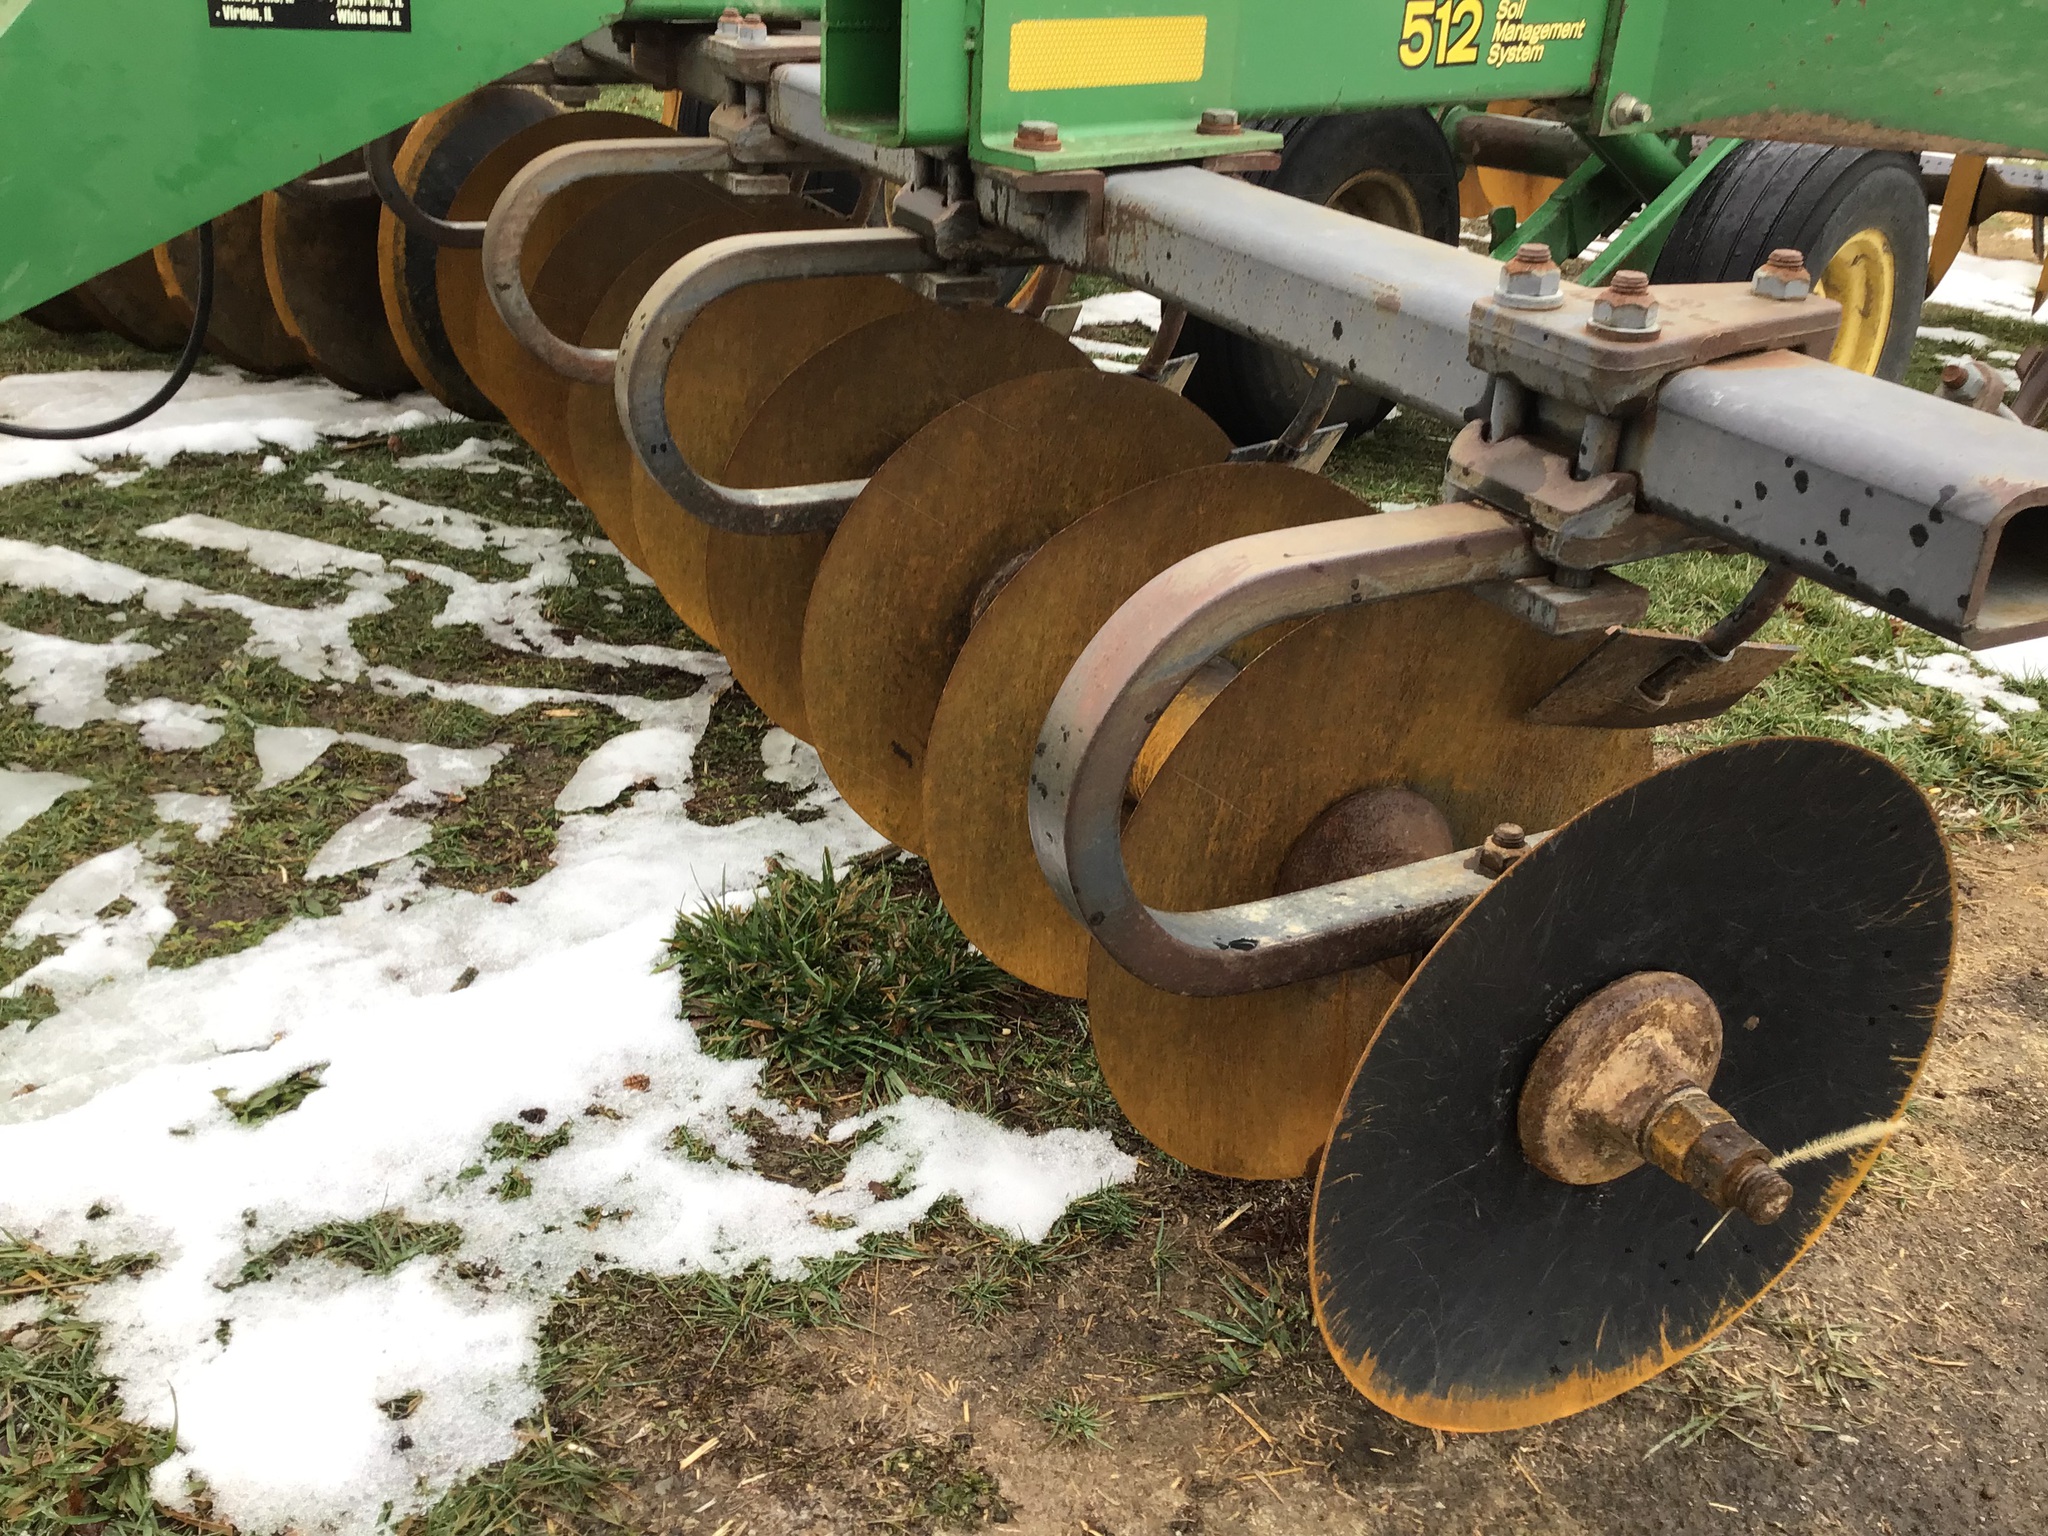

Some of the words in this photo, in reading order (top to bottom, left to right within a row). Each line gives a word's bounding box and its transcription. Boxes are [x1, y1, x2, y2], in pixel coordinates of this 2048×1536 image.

[337, 9, 368, 25] White
[369, 10, 391, 26] Hall,
[1496, 0, 1528, 20] Soil
[1399, 0, 1484, 68] 512
[1491, 18, 1586, 44] Management
[1486, 43, 1545, 69] System
